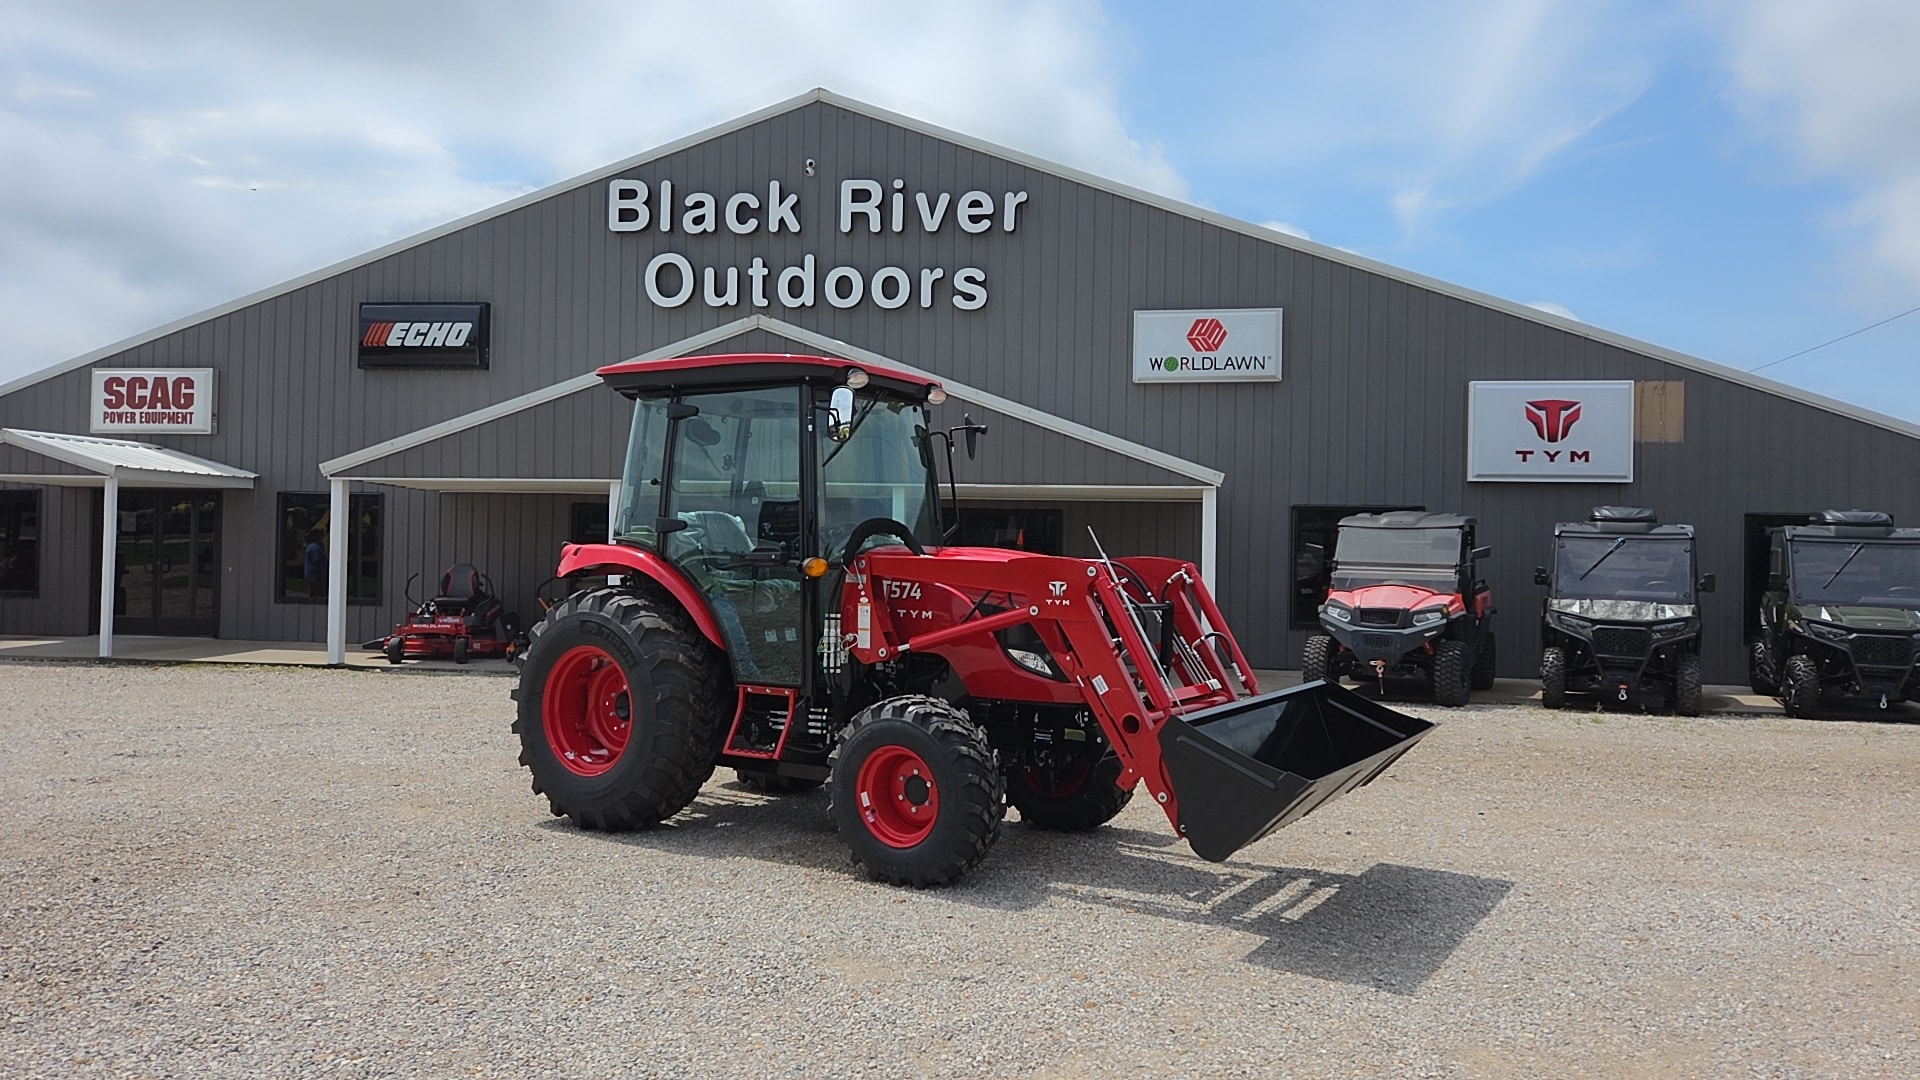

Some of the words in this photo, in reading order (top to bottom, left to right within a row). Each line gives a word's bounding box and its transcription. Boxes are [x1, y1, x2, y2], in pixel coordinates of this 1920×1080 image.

[608, 179, 800, 234] Black
[840, 179, 1028, 234] River
[644, 252, 988, 310] Outdoors
[385, 322, 473, 347] ECHO
[1149, 355, 1266, 372] WORLDLAWN
[103, 376, 195, 410] SCAG
[103, 411, 137, 424] POWER
[139, 411, 195, 425] EQUIPMENT
[1515, 450, 1590, 463] TYM
[897, 609, 932, 619] TYM
